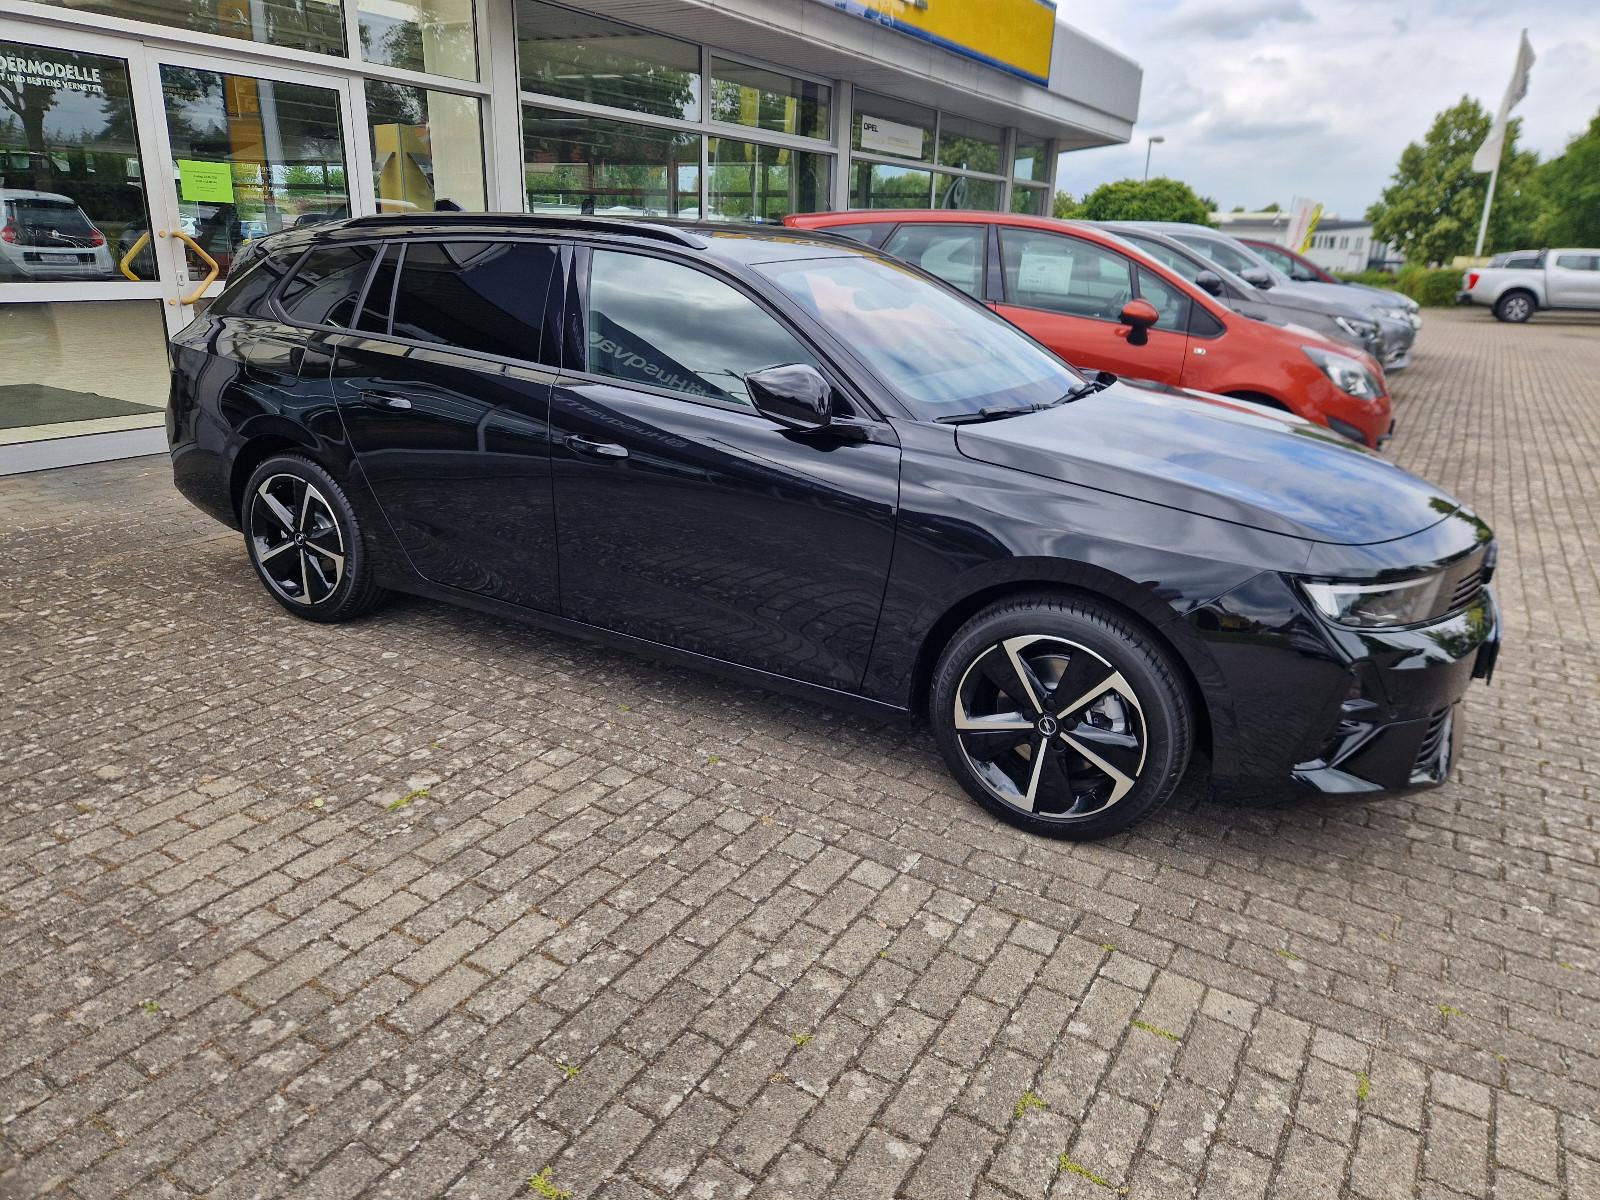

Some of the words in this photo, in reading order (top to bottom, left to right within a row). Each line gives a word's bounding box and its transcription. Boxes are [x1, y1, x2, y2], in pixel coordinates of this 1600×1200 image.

[7, 73, 25, 83] UND
[27, 76, 61, 88] BESTENS
[864, 122, 879, 133] OPEL
